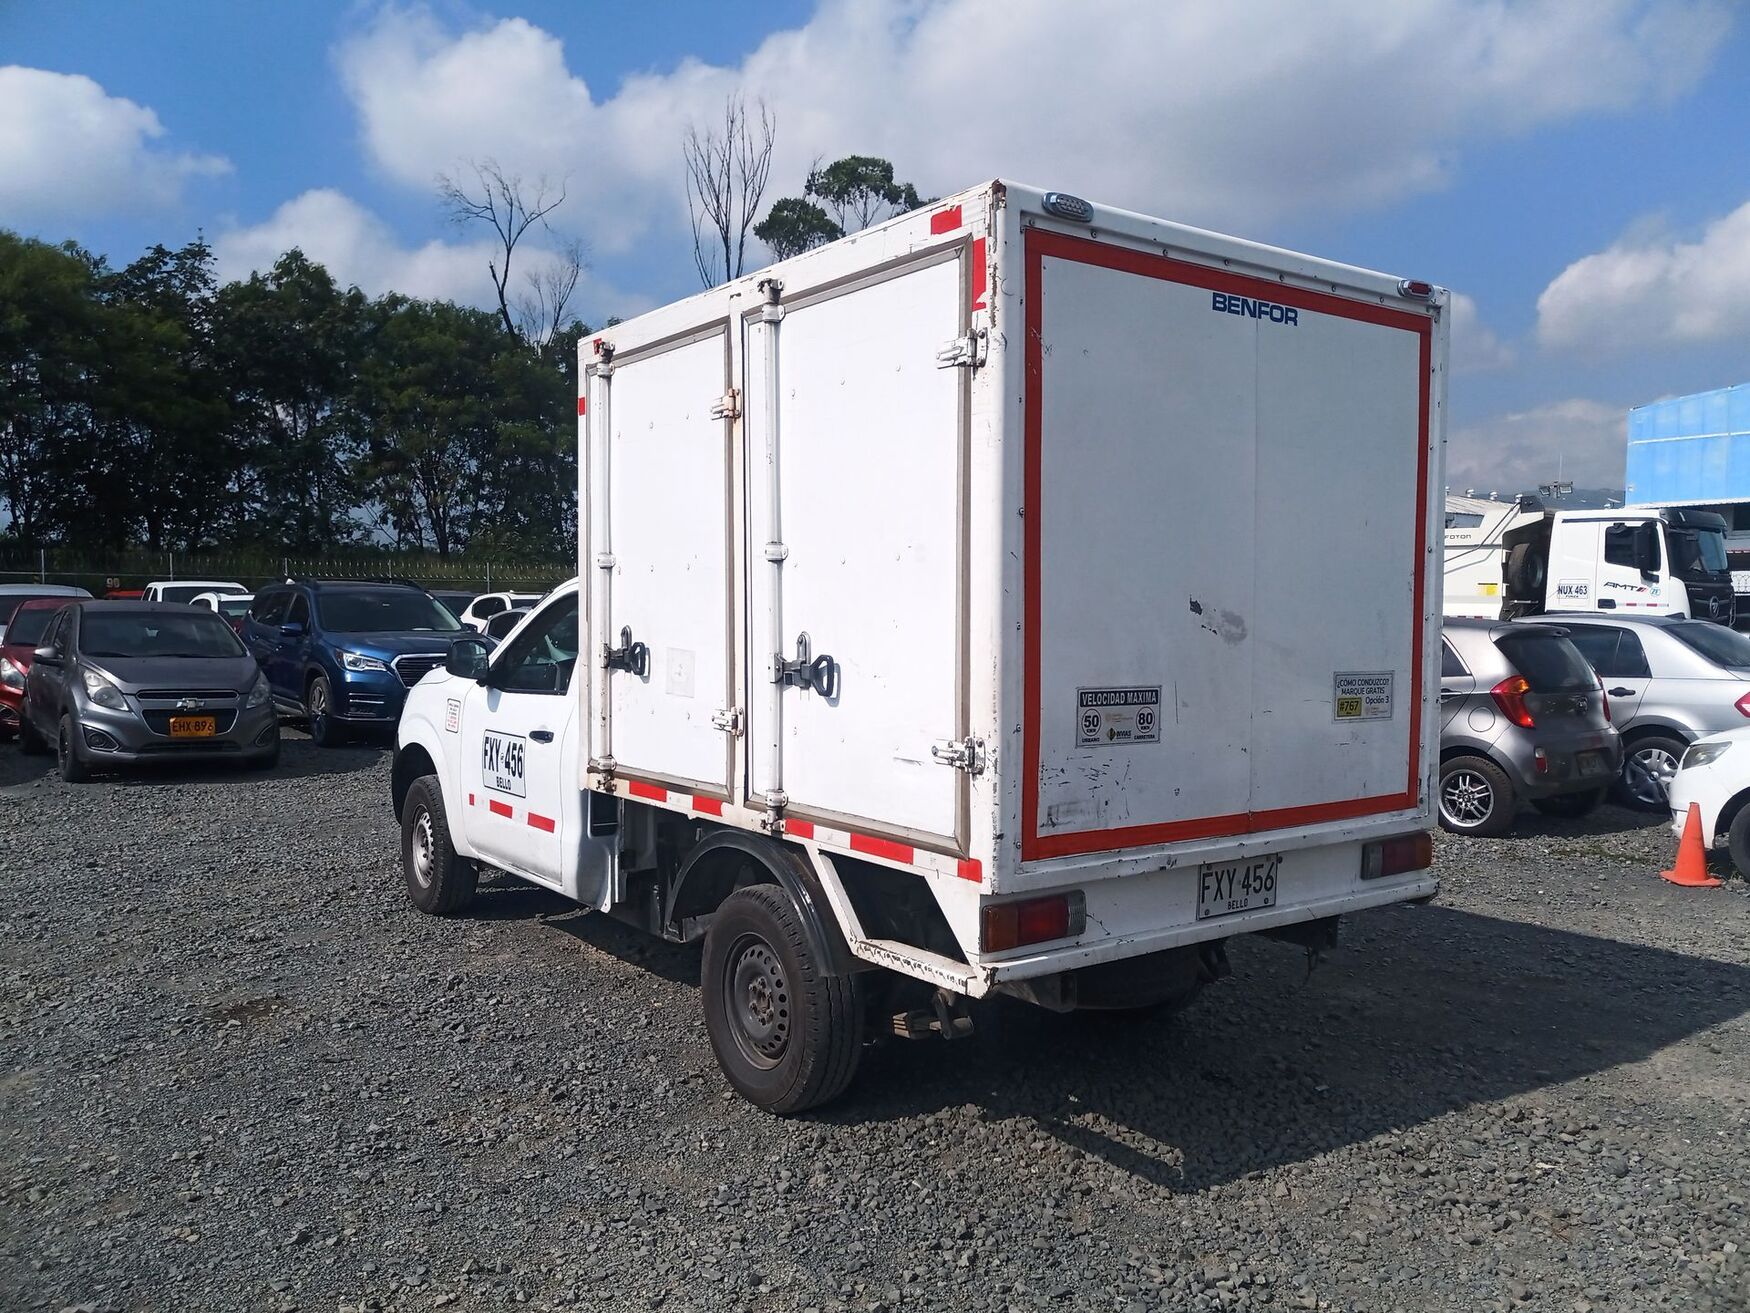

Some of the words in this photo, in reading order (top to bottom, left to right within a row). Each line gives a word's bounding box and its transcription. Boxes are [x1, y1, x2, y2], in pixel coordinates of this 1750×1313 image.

[1212, 292, 1298, 326] BENFOR
[1557, 585, 1573, 595] NUX
[1574, 585, 1588, 595] 463
[1341, 687, 1365, 696] MARQUE
[1082, 692, 1125, 705] VELOCIDAD
[1340, 700, 1359, 711] #767
[1083, 715, 1099, 728] 50
[1138, 712, 1153, 725] 80
[172, 720, 191, 732] EHX
[194, 720, 214, 731] 896
[483, 736, 501, 772] FXY
[505, 741, 523, 779] 456
[496, 776, 512, 790] BELLO
[1201, 868, 1236, 904] FXY
[1242, 861, 1275, 896] 456
[1227, 898, 1249, 910] BELLO
